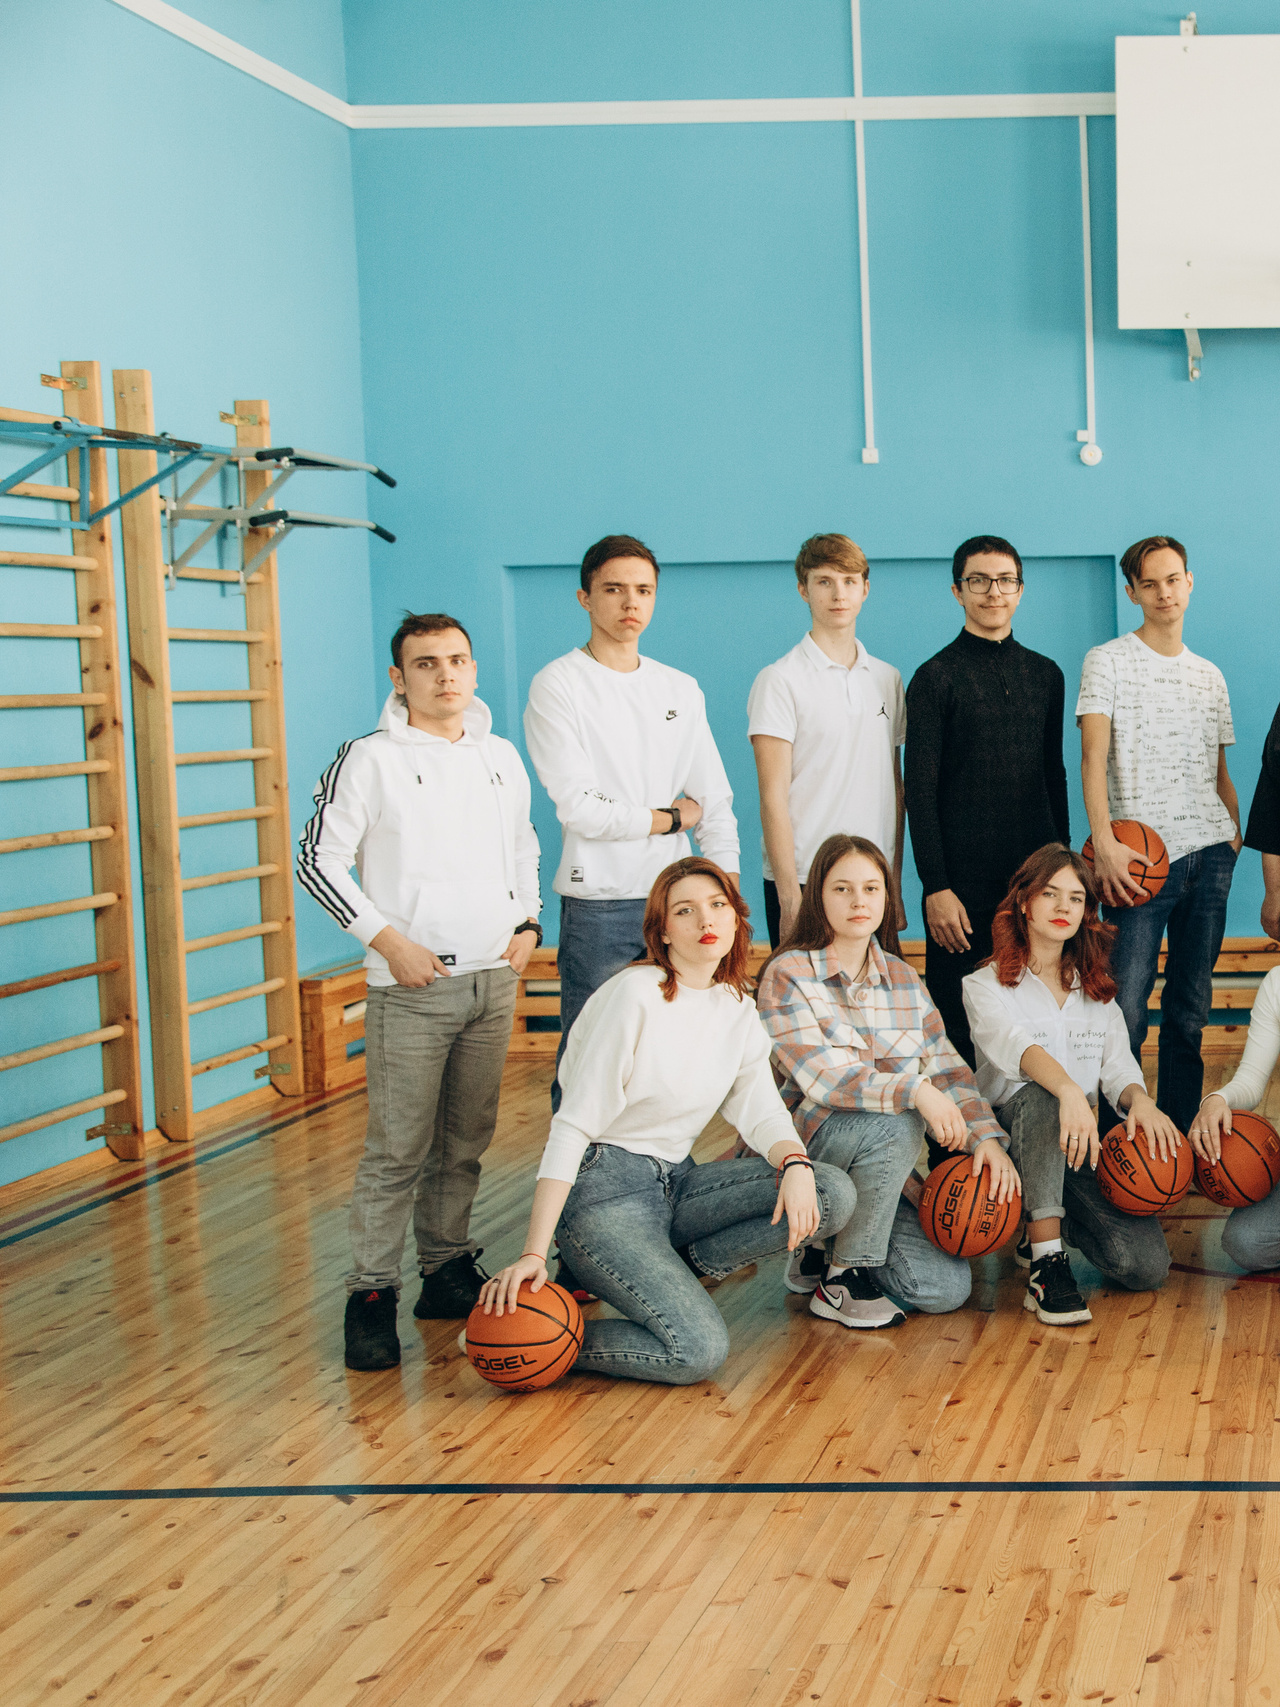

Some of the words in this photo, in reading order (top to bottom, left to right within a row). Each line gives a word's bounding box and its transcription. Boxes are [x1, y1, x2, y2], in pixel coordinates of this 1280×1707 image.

[1076, 1029, 1107, 1039] refuse
[938, 1174, 970, 1239] JÖGEL
[471, 1353, 537, 1370] JÖGEL
